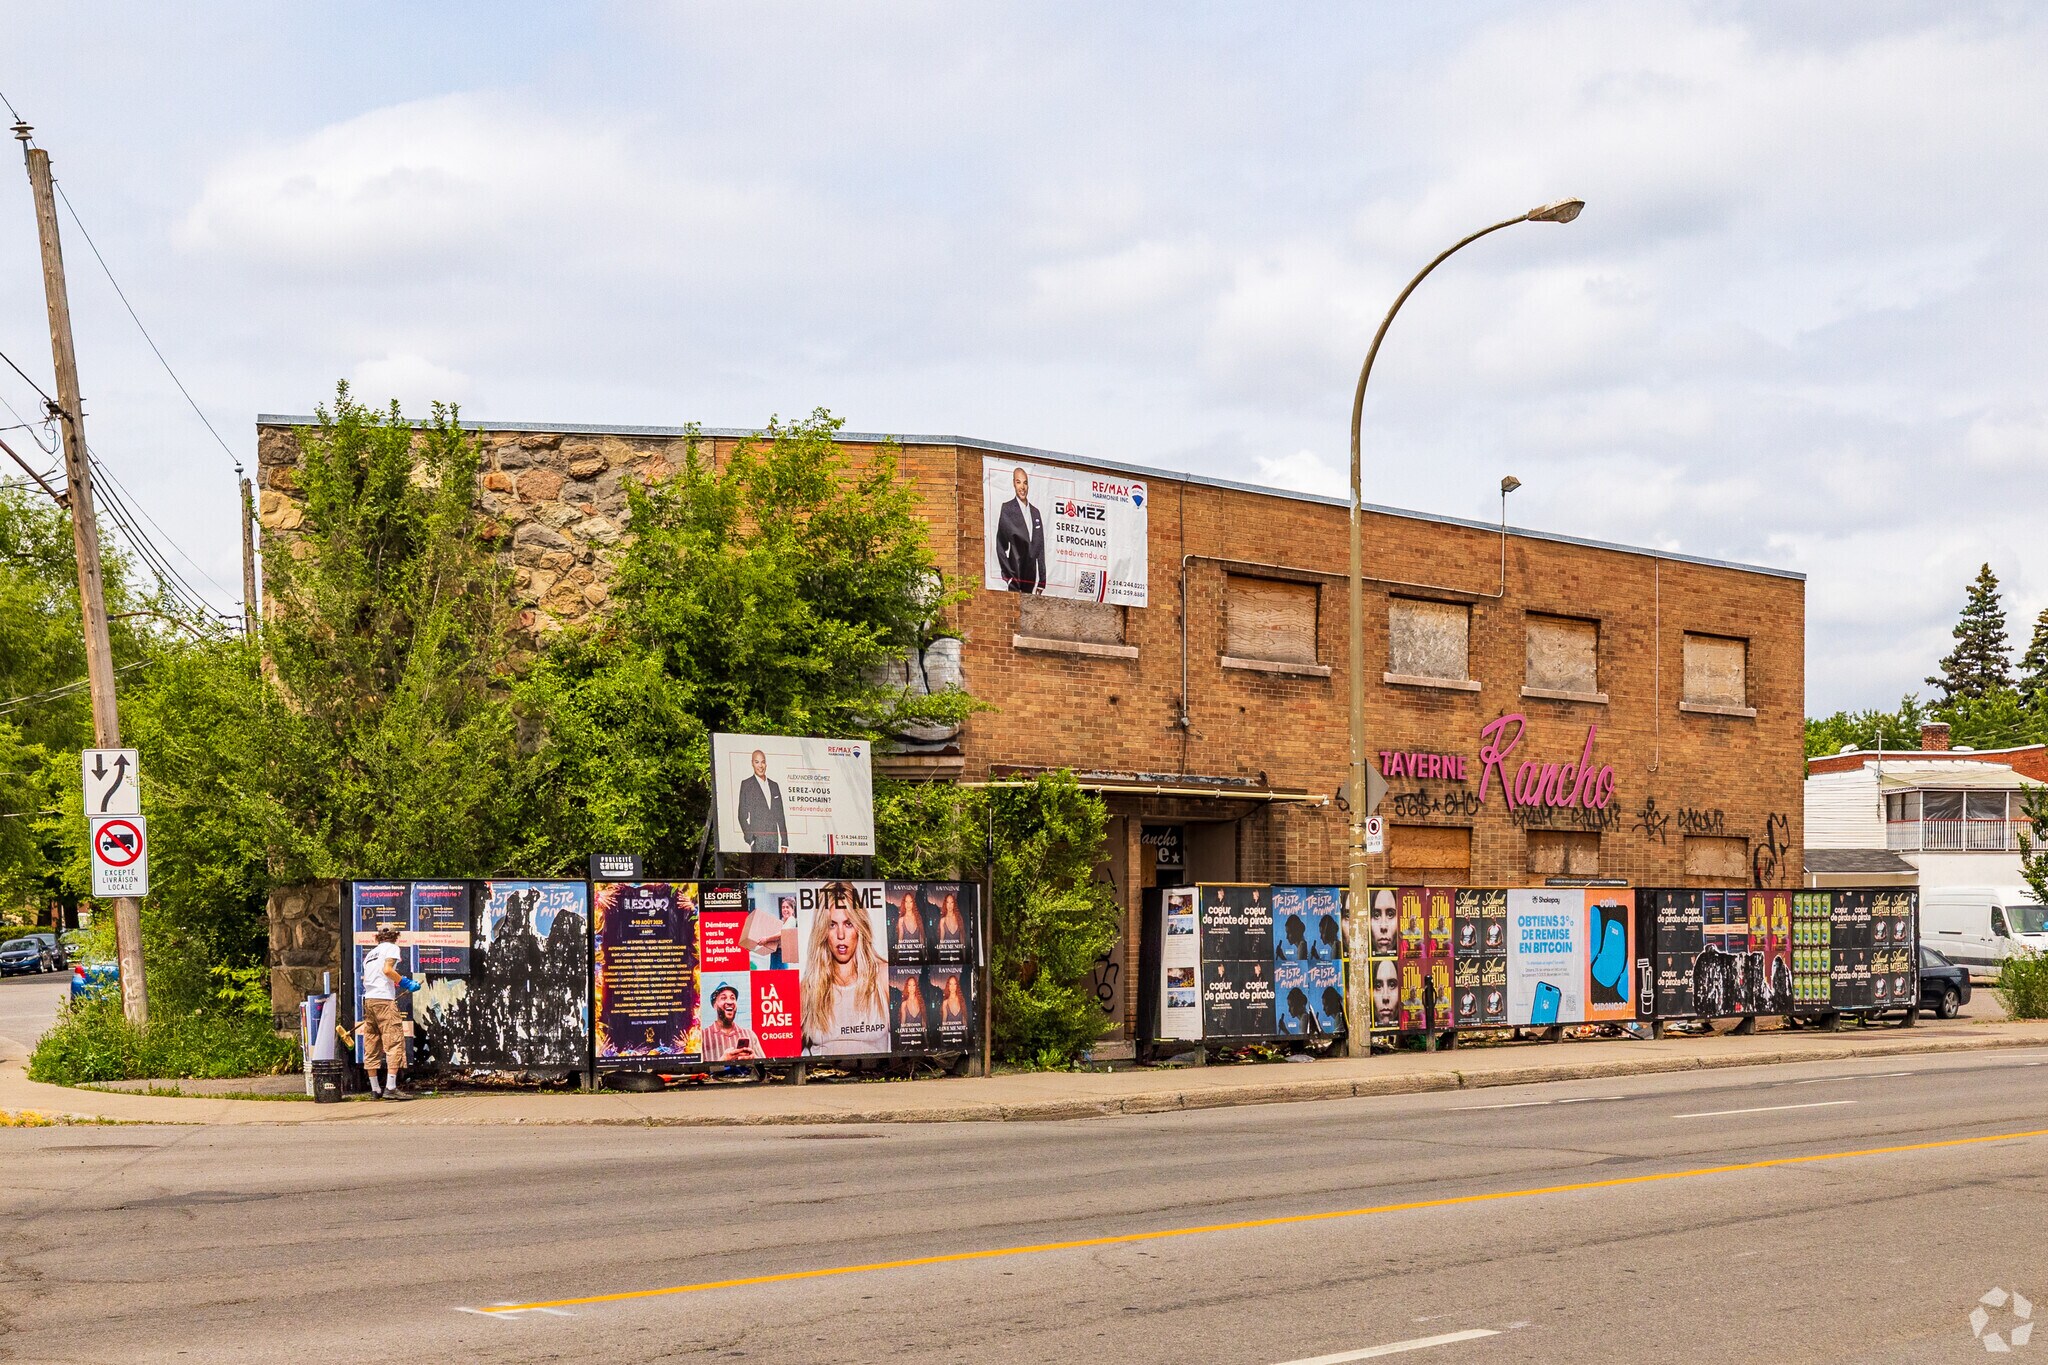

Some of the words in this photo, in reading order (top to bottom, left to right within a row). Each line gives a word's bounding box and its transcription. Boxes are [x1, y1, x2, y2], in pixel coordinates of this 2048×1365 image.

[1092, 481, 1129, 496] RE/MAX
[1092, 493, 1119, 502] HARMONIE
[1056, 522, 1106, 537] SEREZ-VOUS
[1056, 535, 1064, 543] LE
[1066, 536, 1107, 549] PROCHAIN?
[1056, 548, 1107, 561] venduvendu.ca
[1379, 751, 1467, 780] TAVERNE
[1479, 713, 1615, 812] Rancho
[788, 786, 831, 794] SEREZ-VOUS
[1140, 826, 1178, 846] ancho
[105, 868, 135, 876] EXCEPTÉ
[717, 892, 741, 900] OFFRES
[800, 888, 846, 910] BITE
[848, 888, 883, 909] ME
[1538, 896, 1560, 904] Shakepay
[1456, 906, 1480, 915] MTELUS
[1482, 906, 1506, 915] MTELUS
[1202, 914, 1213, 925] de
[1214, 915, 1237, 927] pirate
[1238, 914, 1248, 925] de
[1250, 916, 1273, 927] pirate
[1518, 915, 1558, 927] OBTIENS
[1522, 930, 1534, 940] DE
[1535, 929, 1570, 940] REMISE
[712, 947, 724, 955] plus
[1520, 943, 1532, 953] EN
[1533, 942, 1572, 953] BITCOIN
[1455, 975, 1480, 984] MTELUS
[1482, 974, 1506, 983] MTELUS
[761, 983, 779, 1000] LÀ
[1204, 990, 1214, 1000] de
[1216, 990, 1238, 1002] pirate
[1240, 989, 1250, 1000] de
[1252, 989, 1275, 1002] pirate
[761, 1000, 783, 1014] ON
[761, 1013, 792, 1027] JASE
[865, 1023, 885, 1034] RAPP
